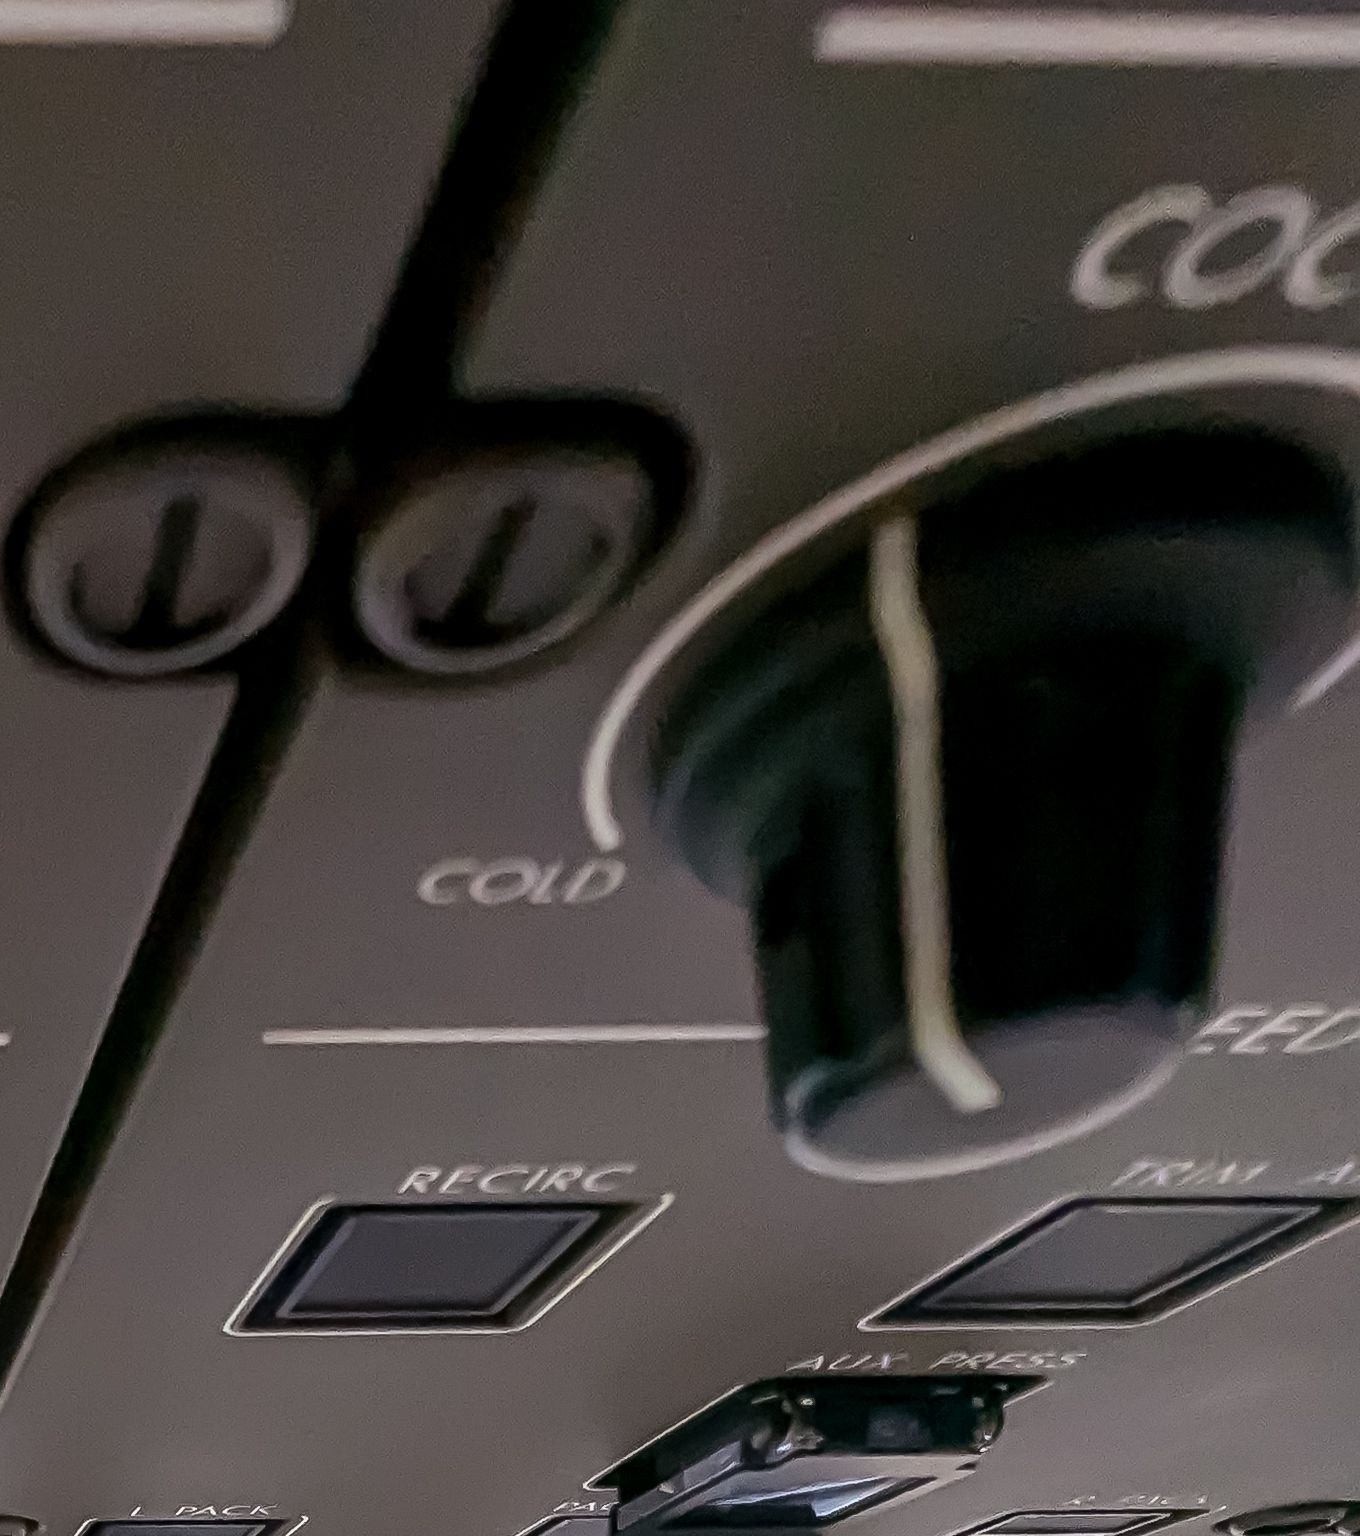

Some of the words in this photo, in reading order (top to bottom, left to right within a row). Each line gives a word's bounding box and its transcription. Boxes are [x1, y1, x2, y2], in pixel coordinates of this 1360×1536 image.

[416, 856, 628, 905] COLD
[397, 1162, 637, 1195] RECIRC
[784, 1353, 910, 1372] AUX
[928, 1352, 1089, 1370] PRESS
[175, 1503, 282, 1517] PACK
